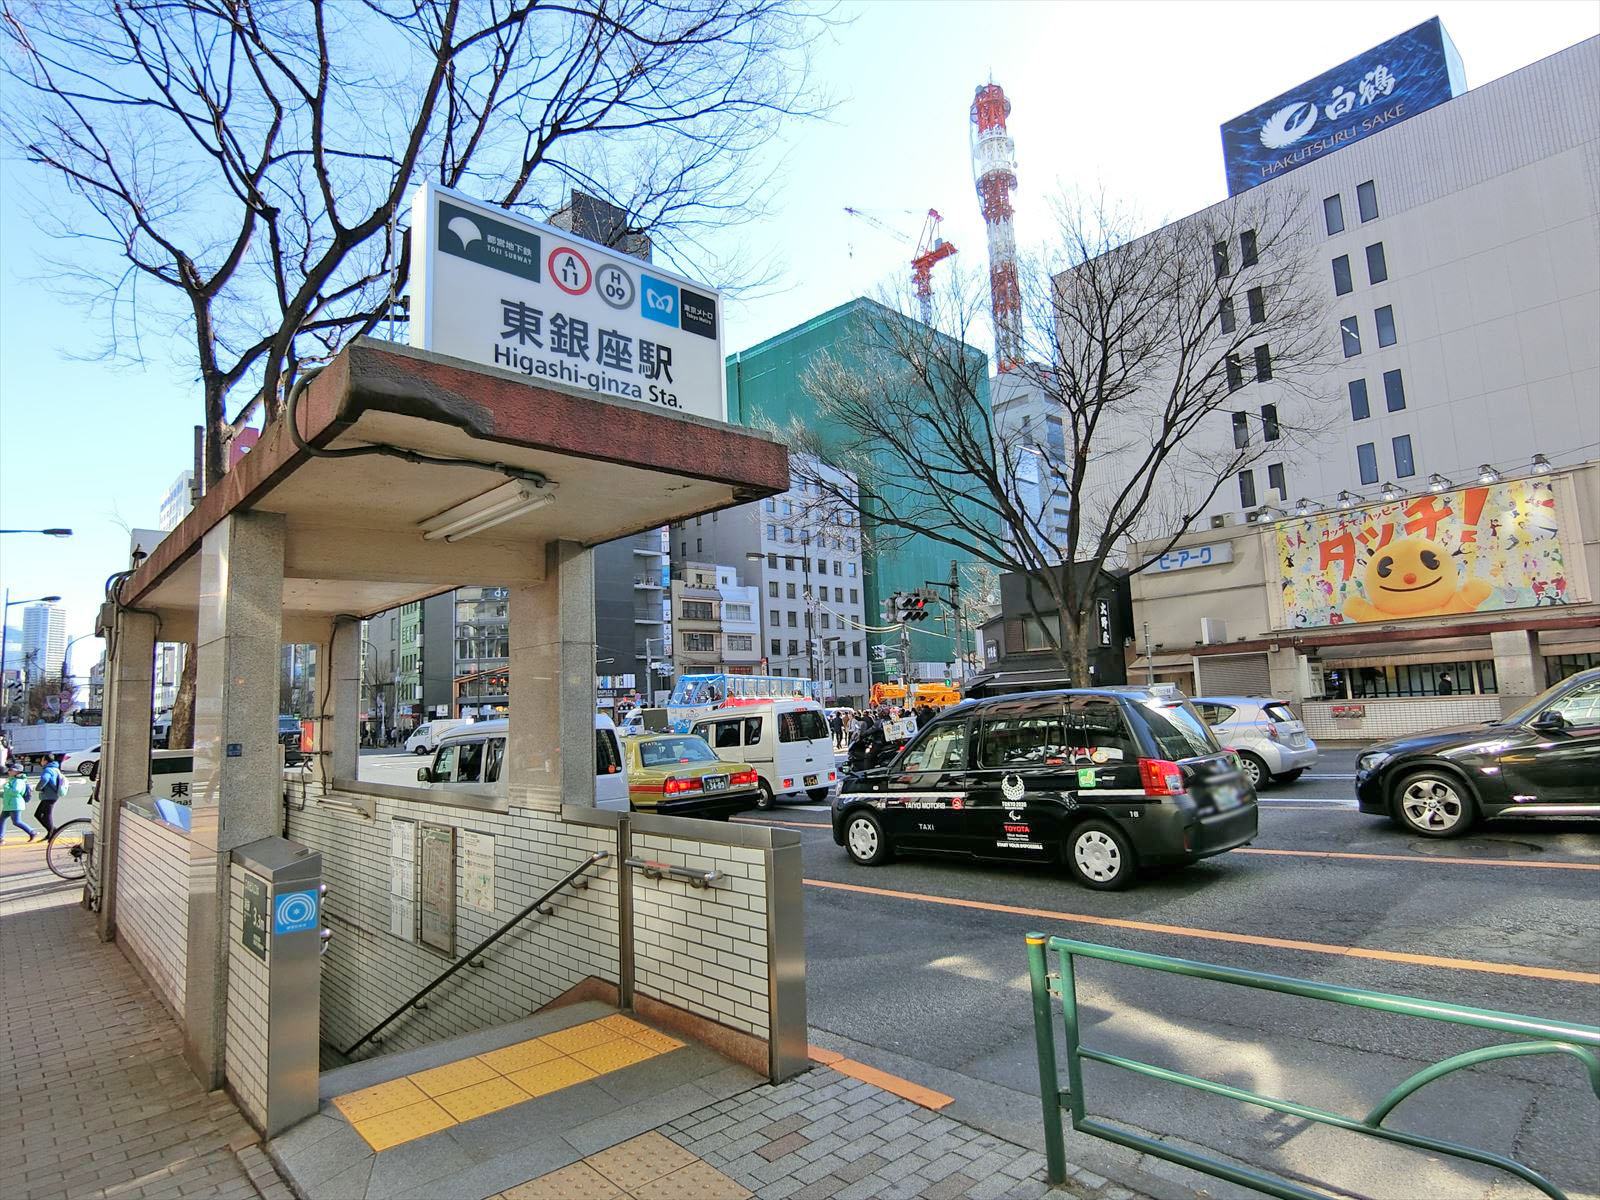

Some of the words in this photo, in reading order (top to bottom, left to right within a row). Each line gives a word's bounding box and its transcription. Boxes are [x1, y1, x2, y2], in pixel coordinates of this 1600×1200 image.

[1324, 64, 1396, 121] 白鶴
[1261, 126, 1357, 177] HAKUTSURU
[1362, 103, 1406, 132] SAKE
[487, 234, 532, 257] 都営地下鉄
[487, 244, 502, 255] TOEI
[504, 250, 532, 265] SUBWAY
[565, 256, 577, 270] A
[562, 268, 579, 286] 11
[611, 271, 621, 286] H
[605, 284, 625, 300] 09
[683, 303, 713, 320] 東京メトロ
[685, 311, 699, 321] Tokyo
[698, 315, 712, 326] Metro
[500, 298, 673, 384] 東銀座駅
[494, 344, 642, 399] Higashi-ginza
[648, 385, 683, 408] Sta.
[918, 823, 935, 831] TAXI
[1004, 825, 1031, 833] TOYOTA
